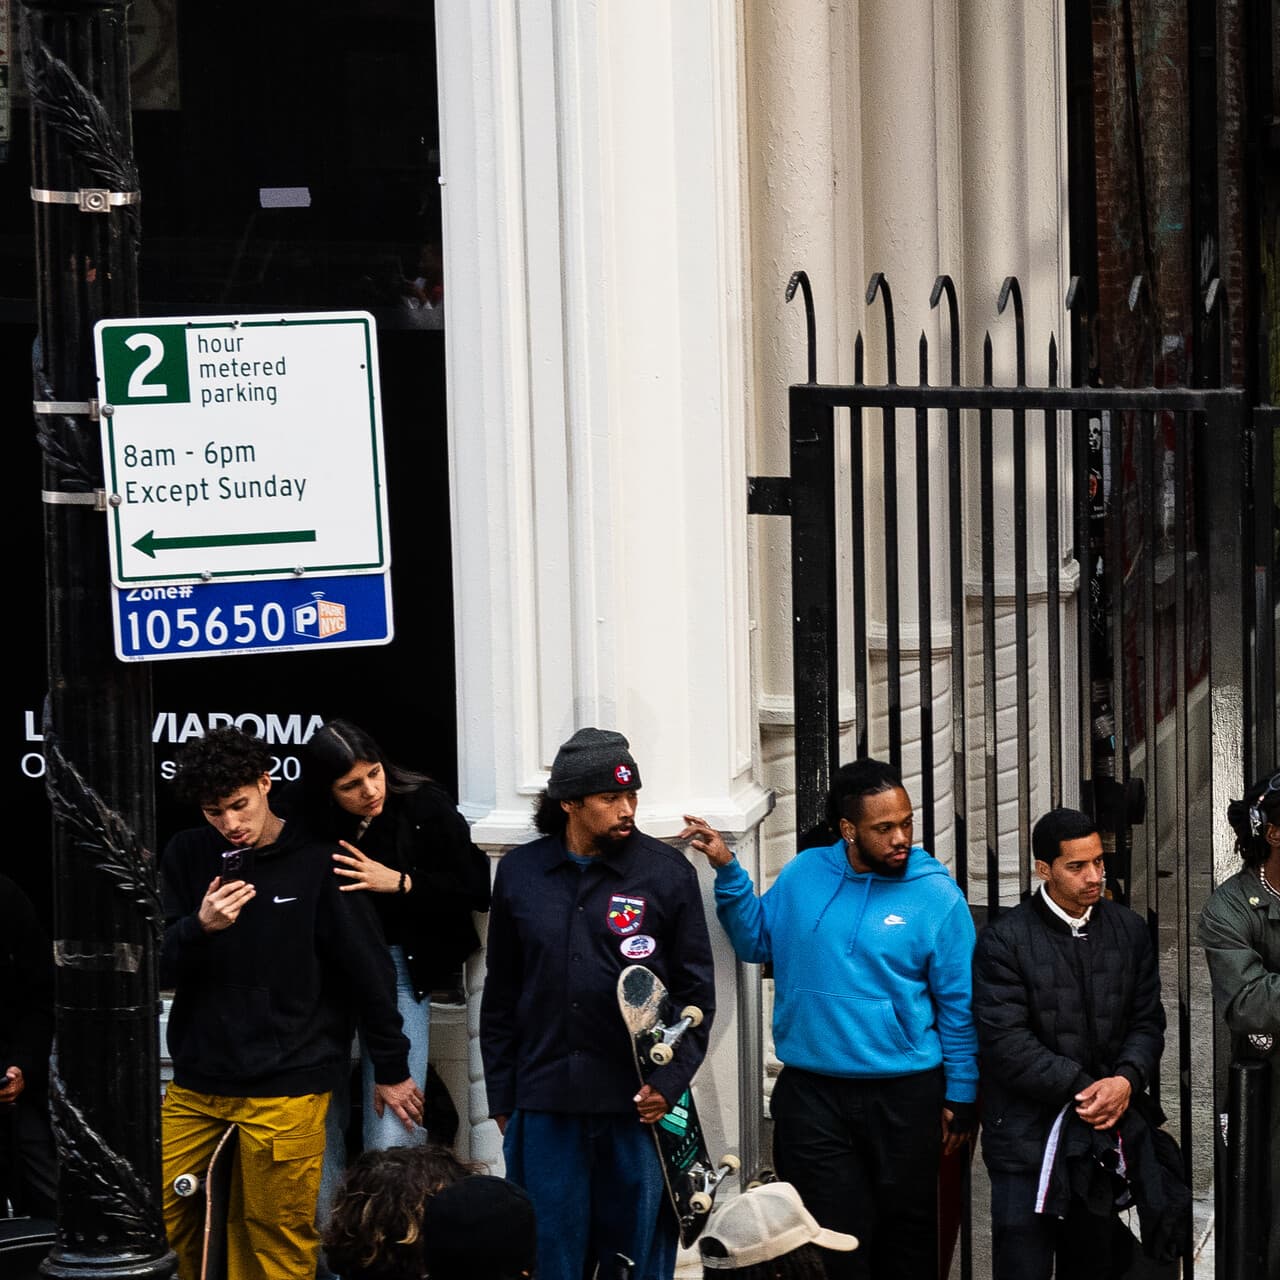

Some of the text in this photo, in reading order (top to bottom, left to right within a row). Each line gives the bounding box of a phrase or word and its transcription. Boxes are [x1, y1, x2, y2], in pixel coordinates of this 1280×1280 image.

[197, 334, 244, 353] hour
[124, 332, 168, 398] 2
[199, 357, 287, 379] metered
[201, 382, 278, 407] parking
[124, 444, 176, 468] 8am
[203, 441, 256, 468] 6pm
[126, 474, 307, 507] Except Sunday
[126, 585, 194, 601] Zone#
[320, 604, 345, 617] PARK
[127, 602, 286, 650] 105650
[320, 617, 345, 633] NYC
